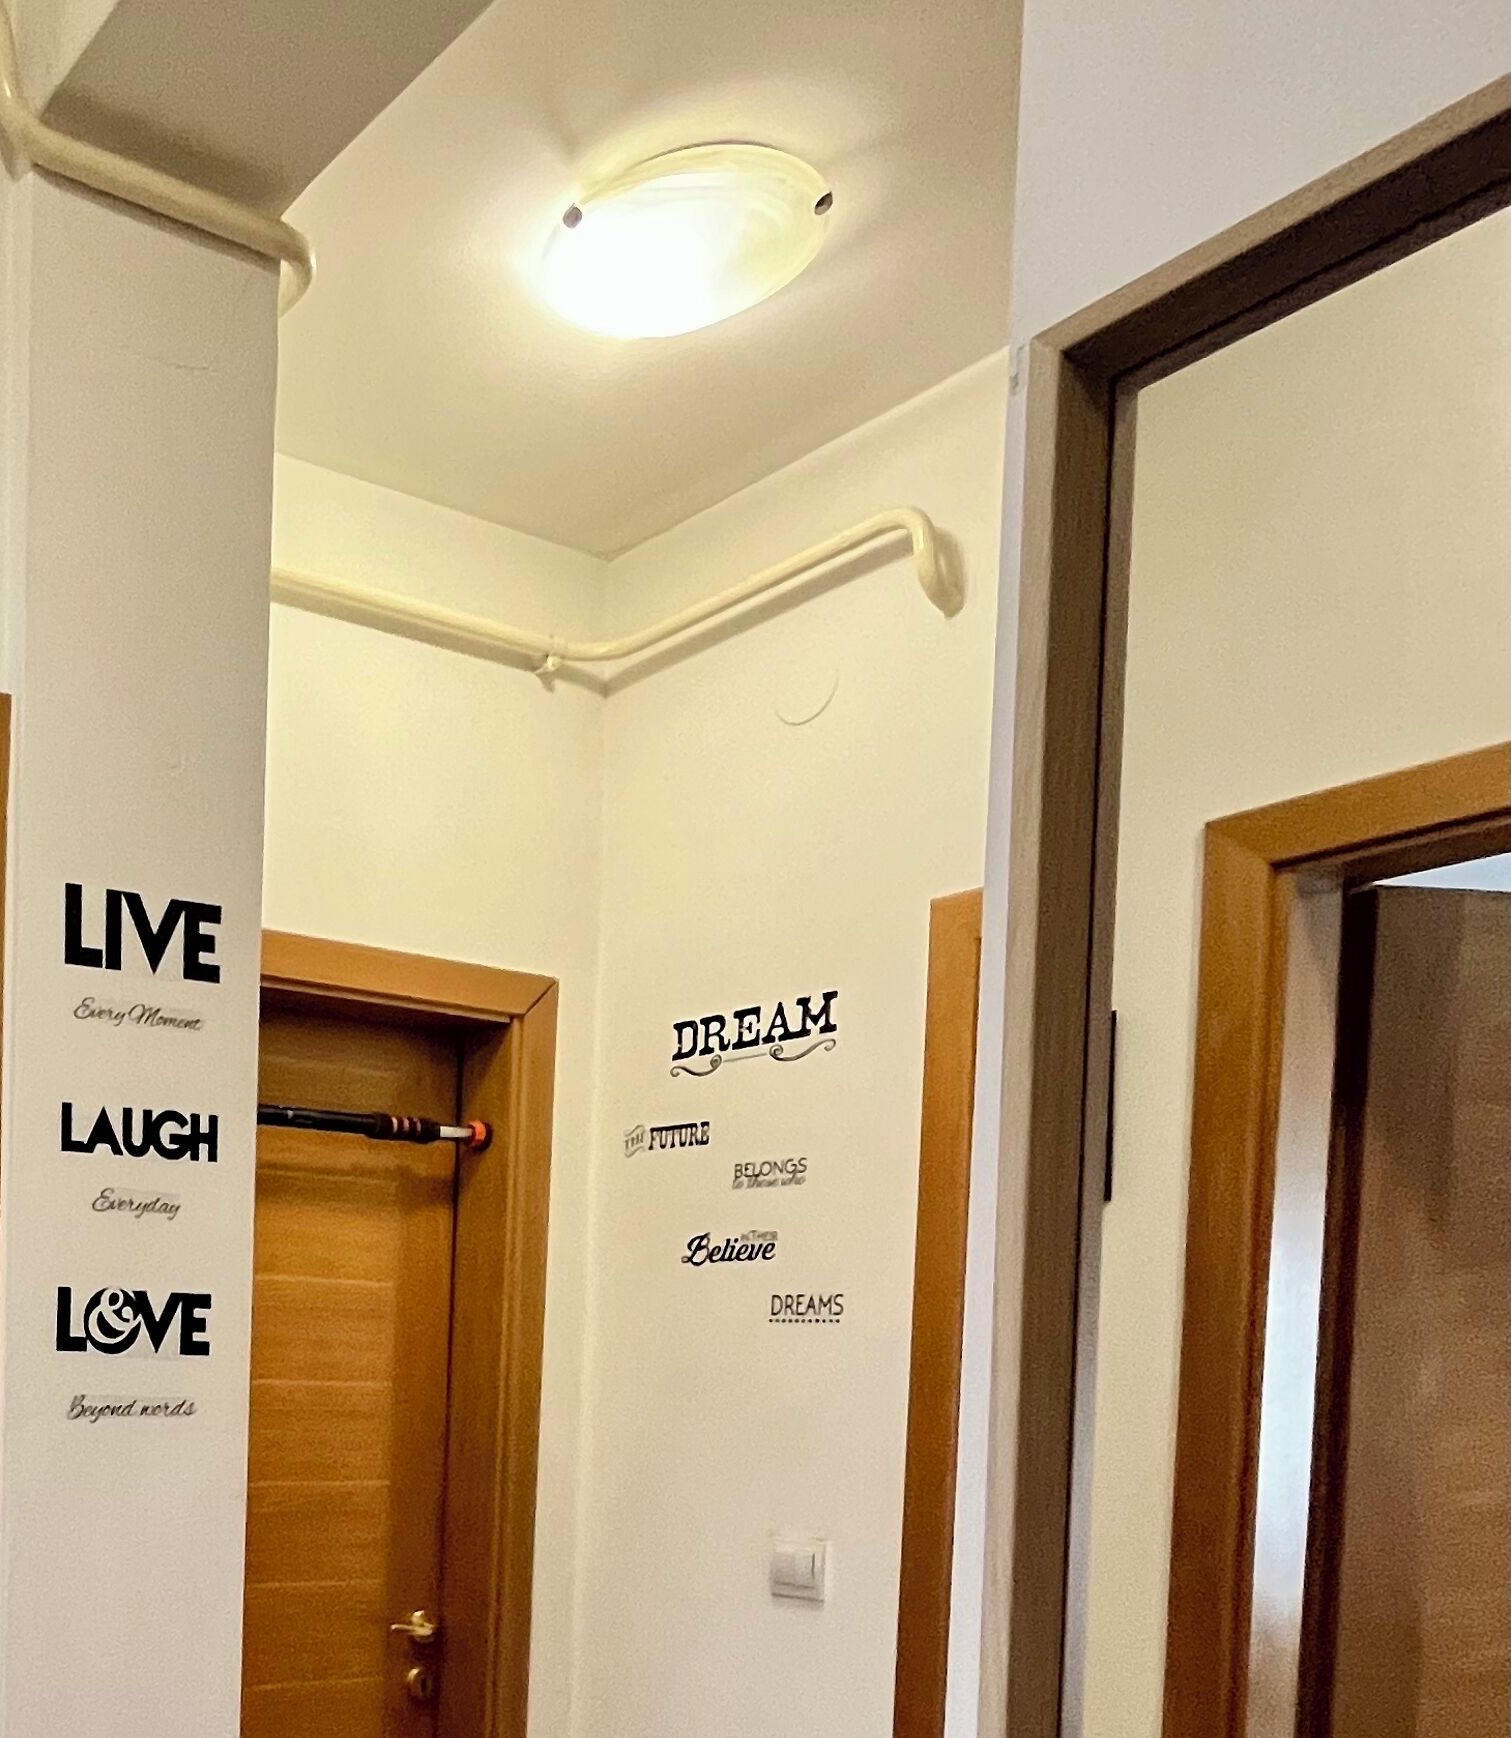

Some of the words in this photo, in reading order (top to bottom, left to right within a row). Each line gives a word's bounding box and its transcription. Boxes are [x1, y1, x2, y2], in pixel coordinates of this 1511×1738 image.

[63, 882, 222, 983] LIVE
[73, 997, 127, 1027] Every
[128, 1003, 201, 1031] Moment
[671, 990, 838, 1062] DREAM
[60, 1102, 218, 1162] LAUGH
[648, 1121, 710, 1150] FUTURE
[733, 1157, 808, 1180] BELONGS
[92, 1188, 181, 1219] Everyday
[681, 1231, 775, 1266] Believe
[770, 1294, 844, 1316] DREAMS
[68, 1394, 138, 1423] Beyond
